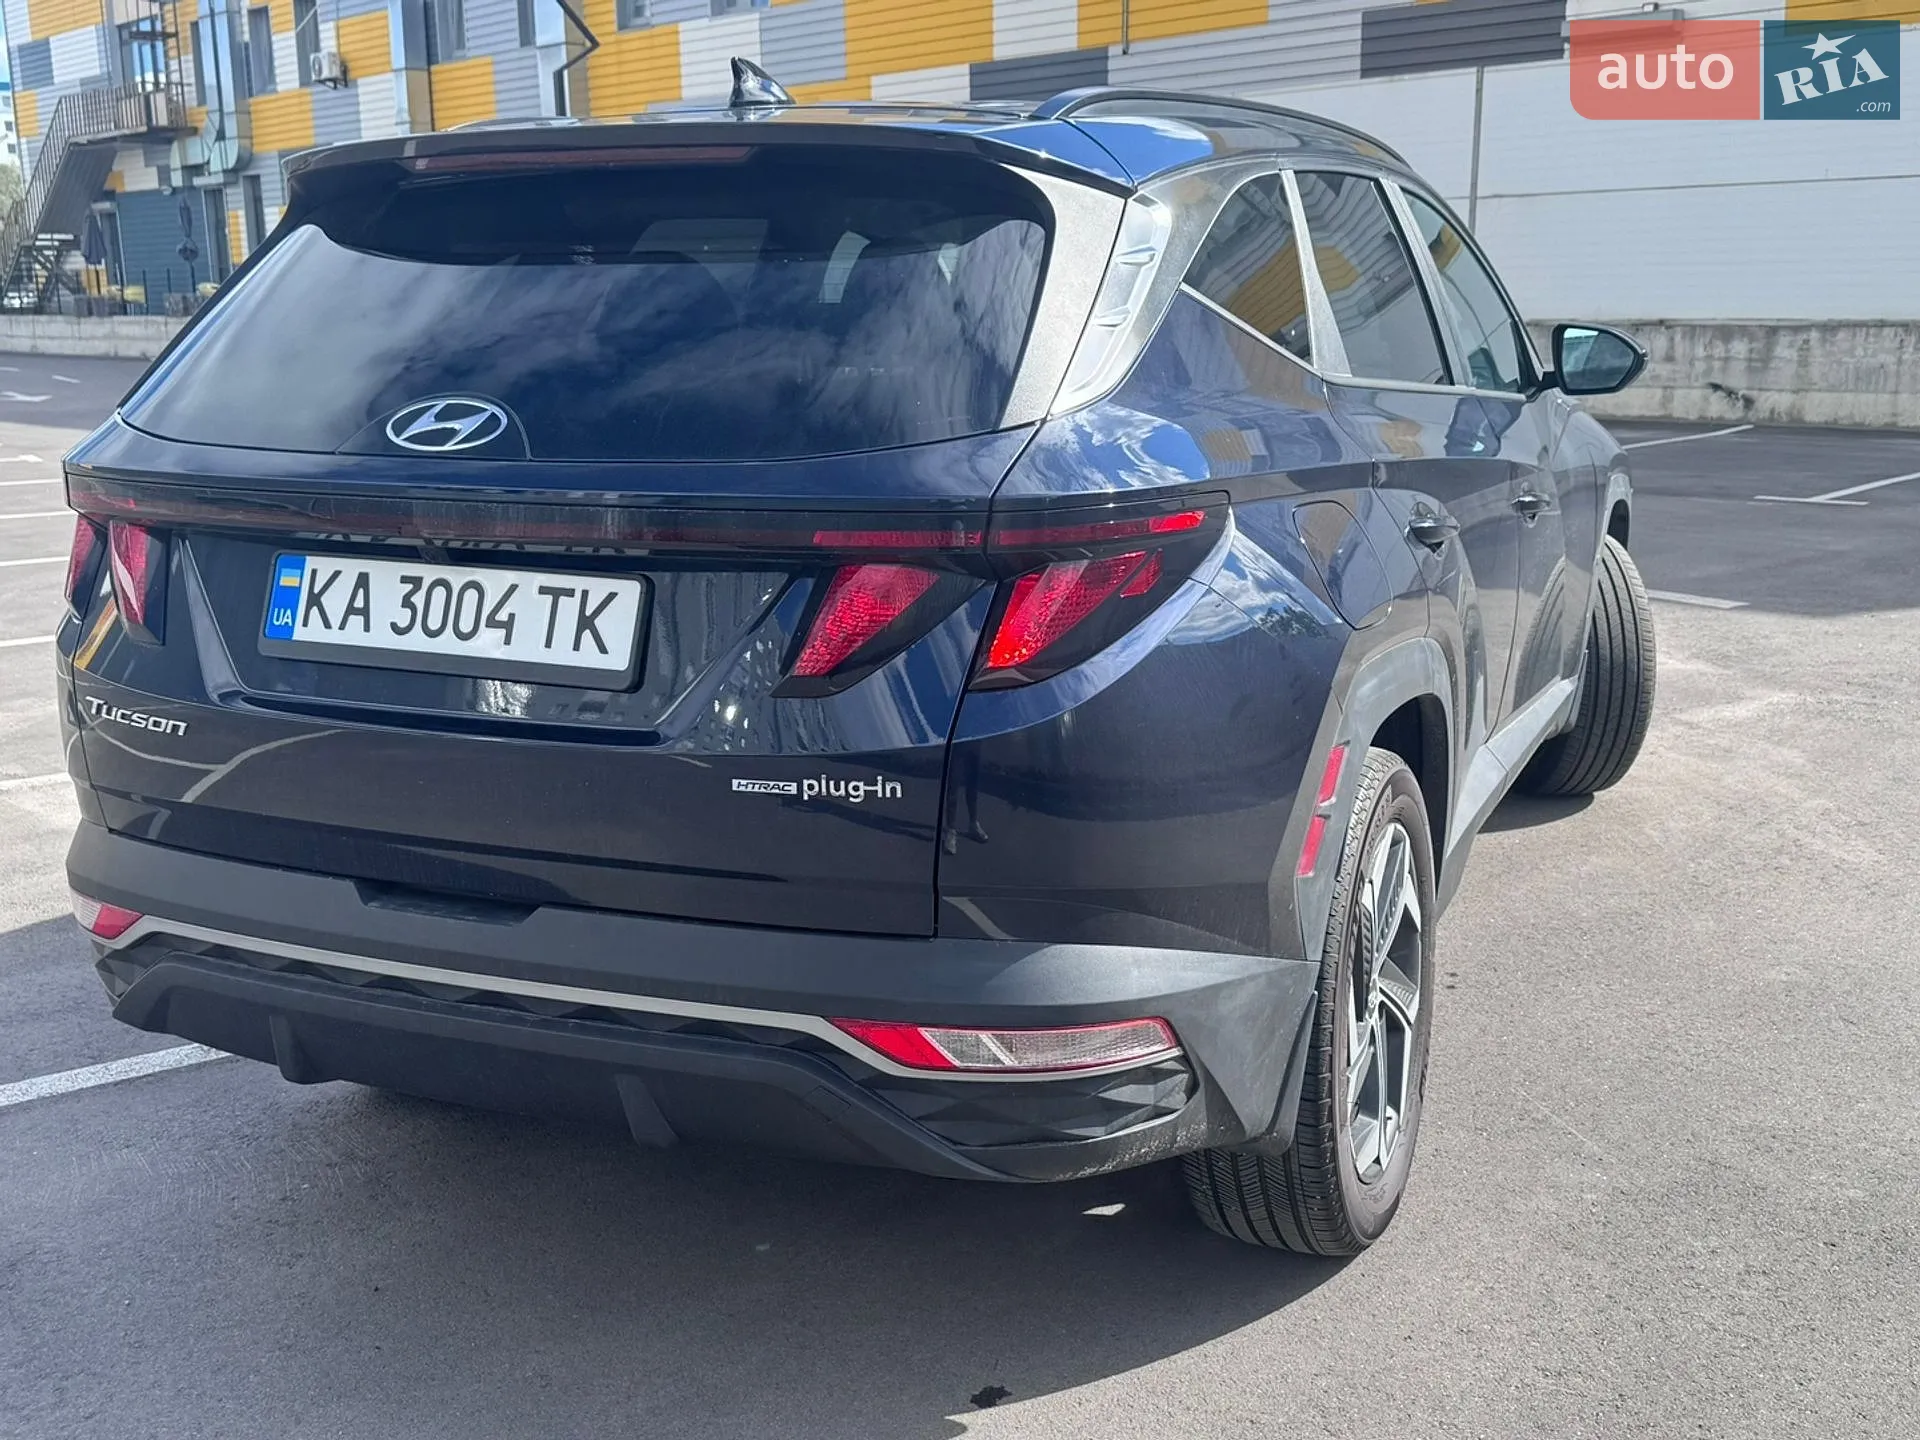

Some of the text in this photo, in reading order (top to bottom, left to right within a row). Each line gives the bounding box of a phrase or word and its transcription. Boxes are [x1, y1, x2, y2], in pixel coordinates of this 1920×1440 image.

[273, 607, 293, 627] UA
[301, 568, 619, 655] KA 3004 TK
[735, 774, 903, 803] HTRAC plug-in
